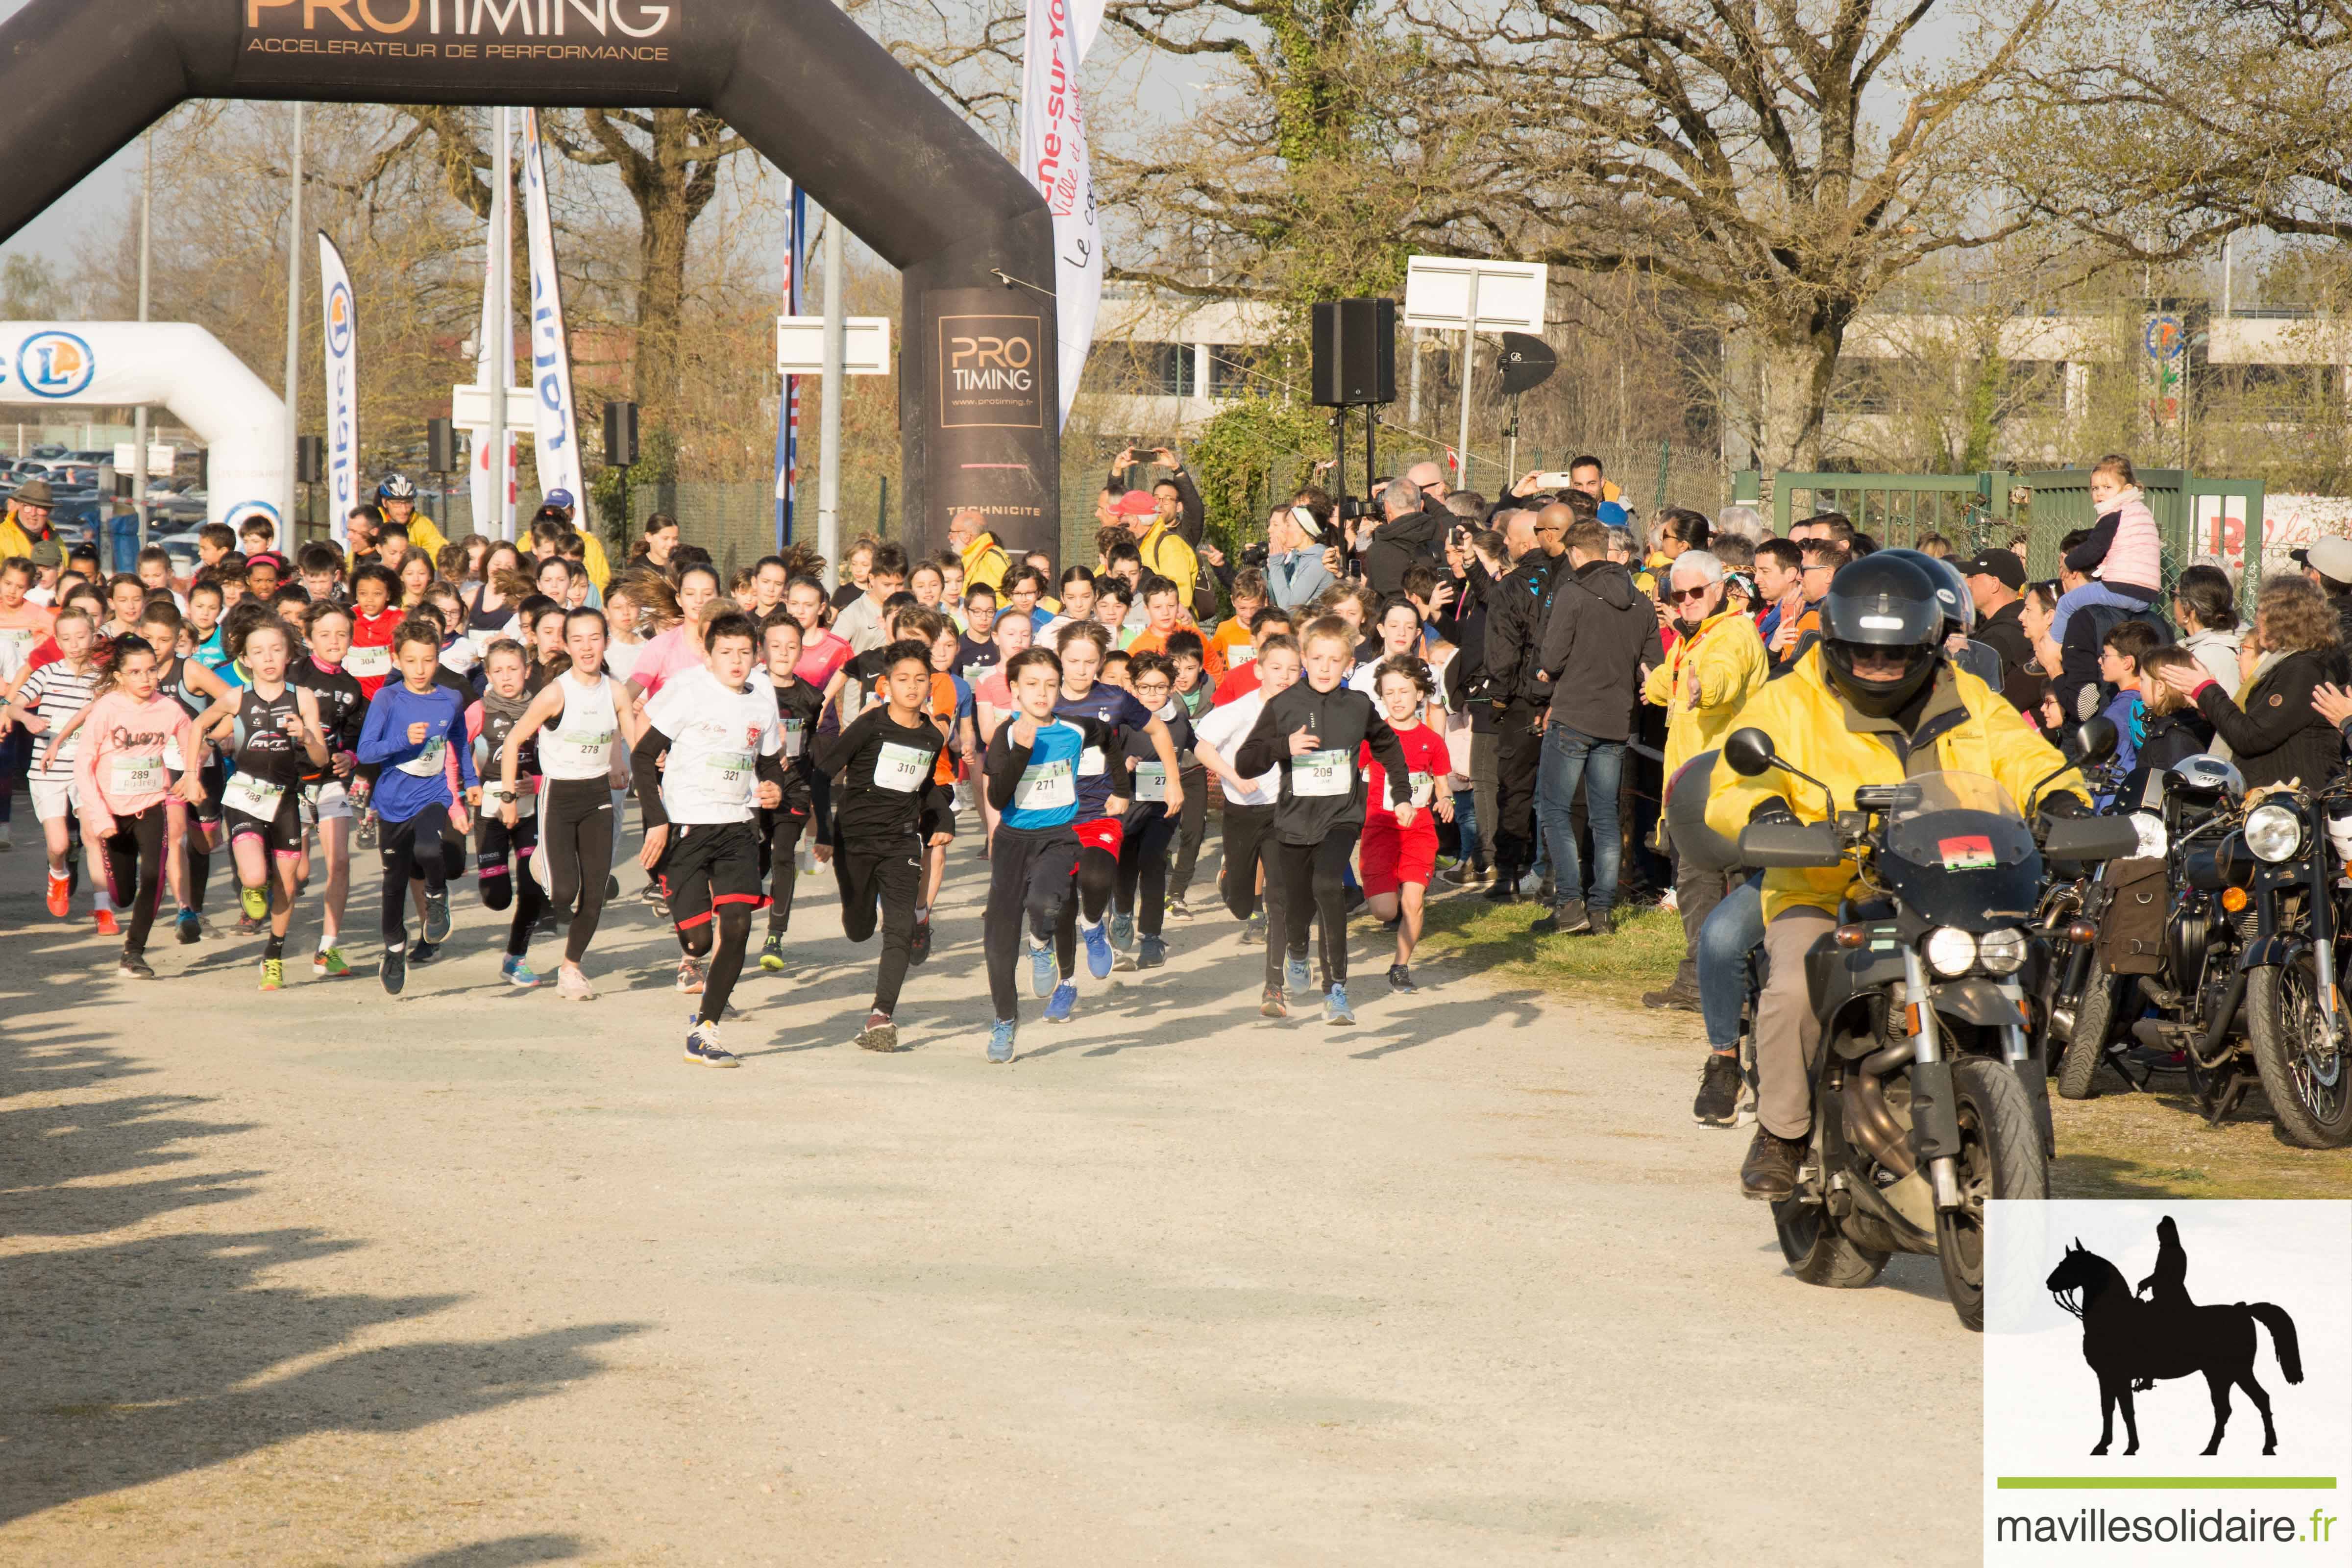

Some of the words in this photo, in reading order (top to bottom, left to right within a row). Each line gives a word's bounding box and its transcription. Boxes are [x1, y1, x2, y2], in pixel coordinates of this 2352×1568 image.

[247, 38, 437, 57] ACCELERATEUR
[445, 45, 478, 58] DE
[486, 45, 668, 61] PERFORMANCE
[1063, 239, 1090, 268] Le
[951, 337, 1031, 368] PRO
[952, 369, 1031, 391] TIMING
[581, 745, 599, 754] 278
[131, 770, 149, 779] 289
[897, 762, 916, 775] 310
[1313, 767, 1333, 777] 209
[723, 770, 739, 781] 321
[1036, 779, 1054, 791] 271
[245, 789, 261, 802] 288
